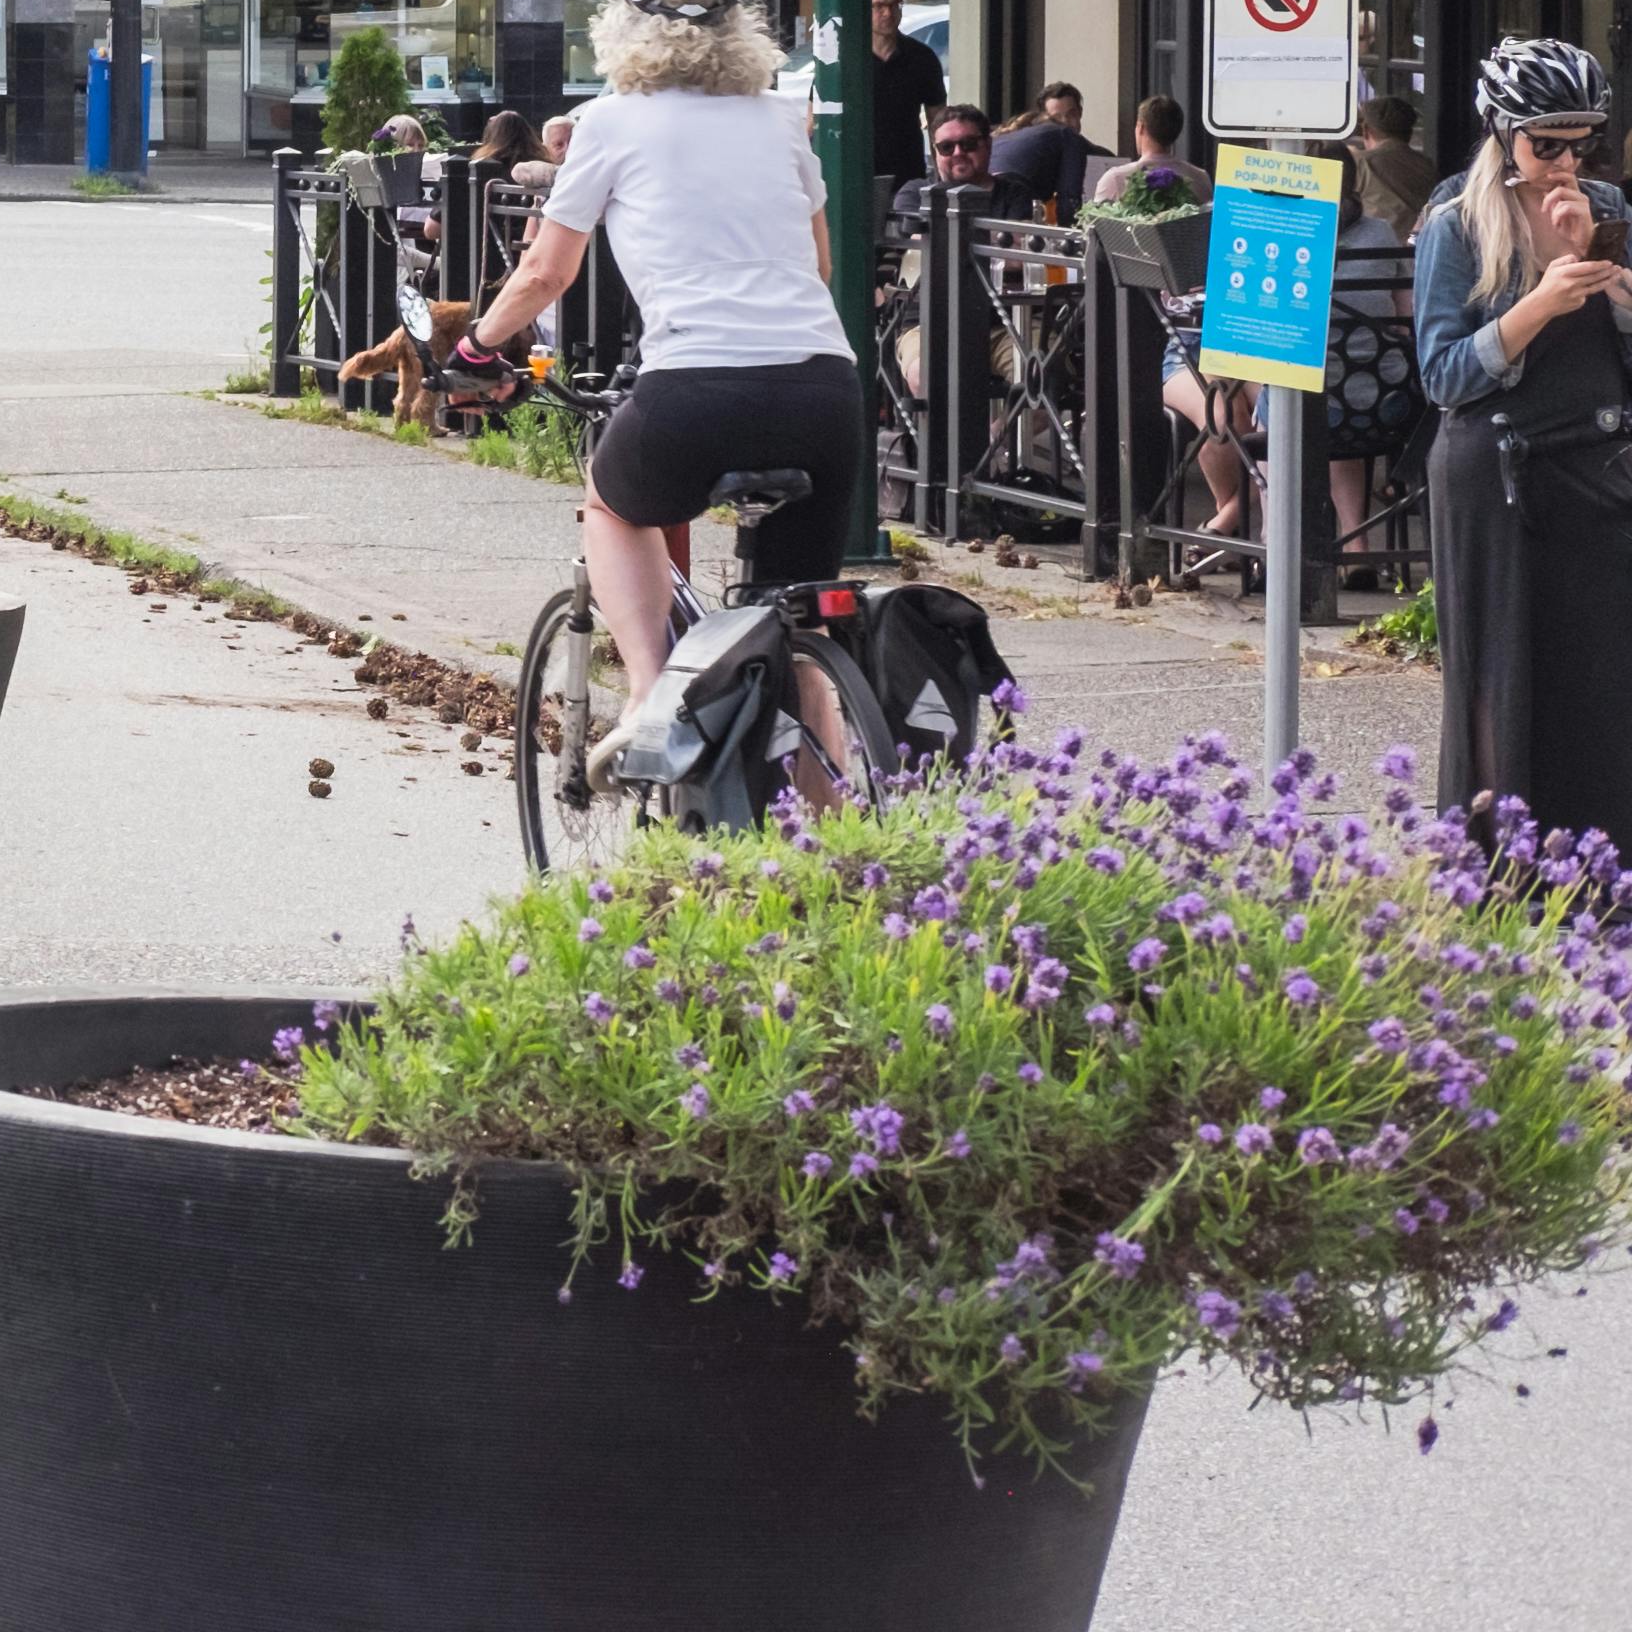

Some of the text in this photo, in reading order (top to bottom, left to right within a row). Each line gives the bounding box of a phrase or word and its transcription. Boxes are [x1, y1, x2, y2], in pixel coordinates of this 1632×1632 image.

[1244, 155, 1313, 175] ENJOY THIS
[1235, 169, 1320, 192] POP-UP PLAZA
